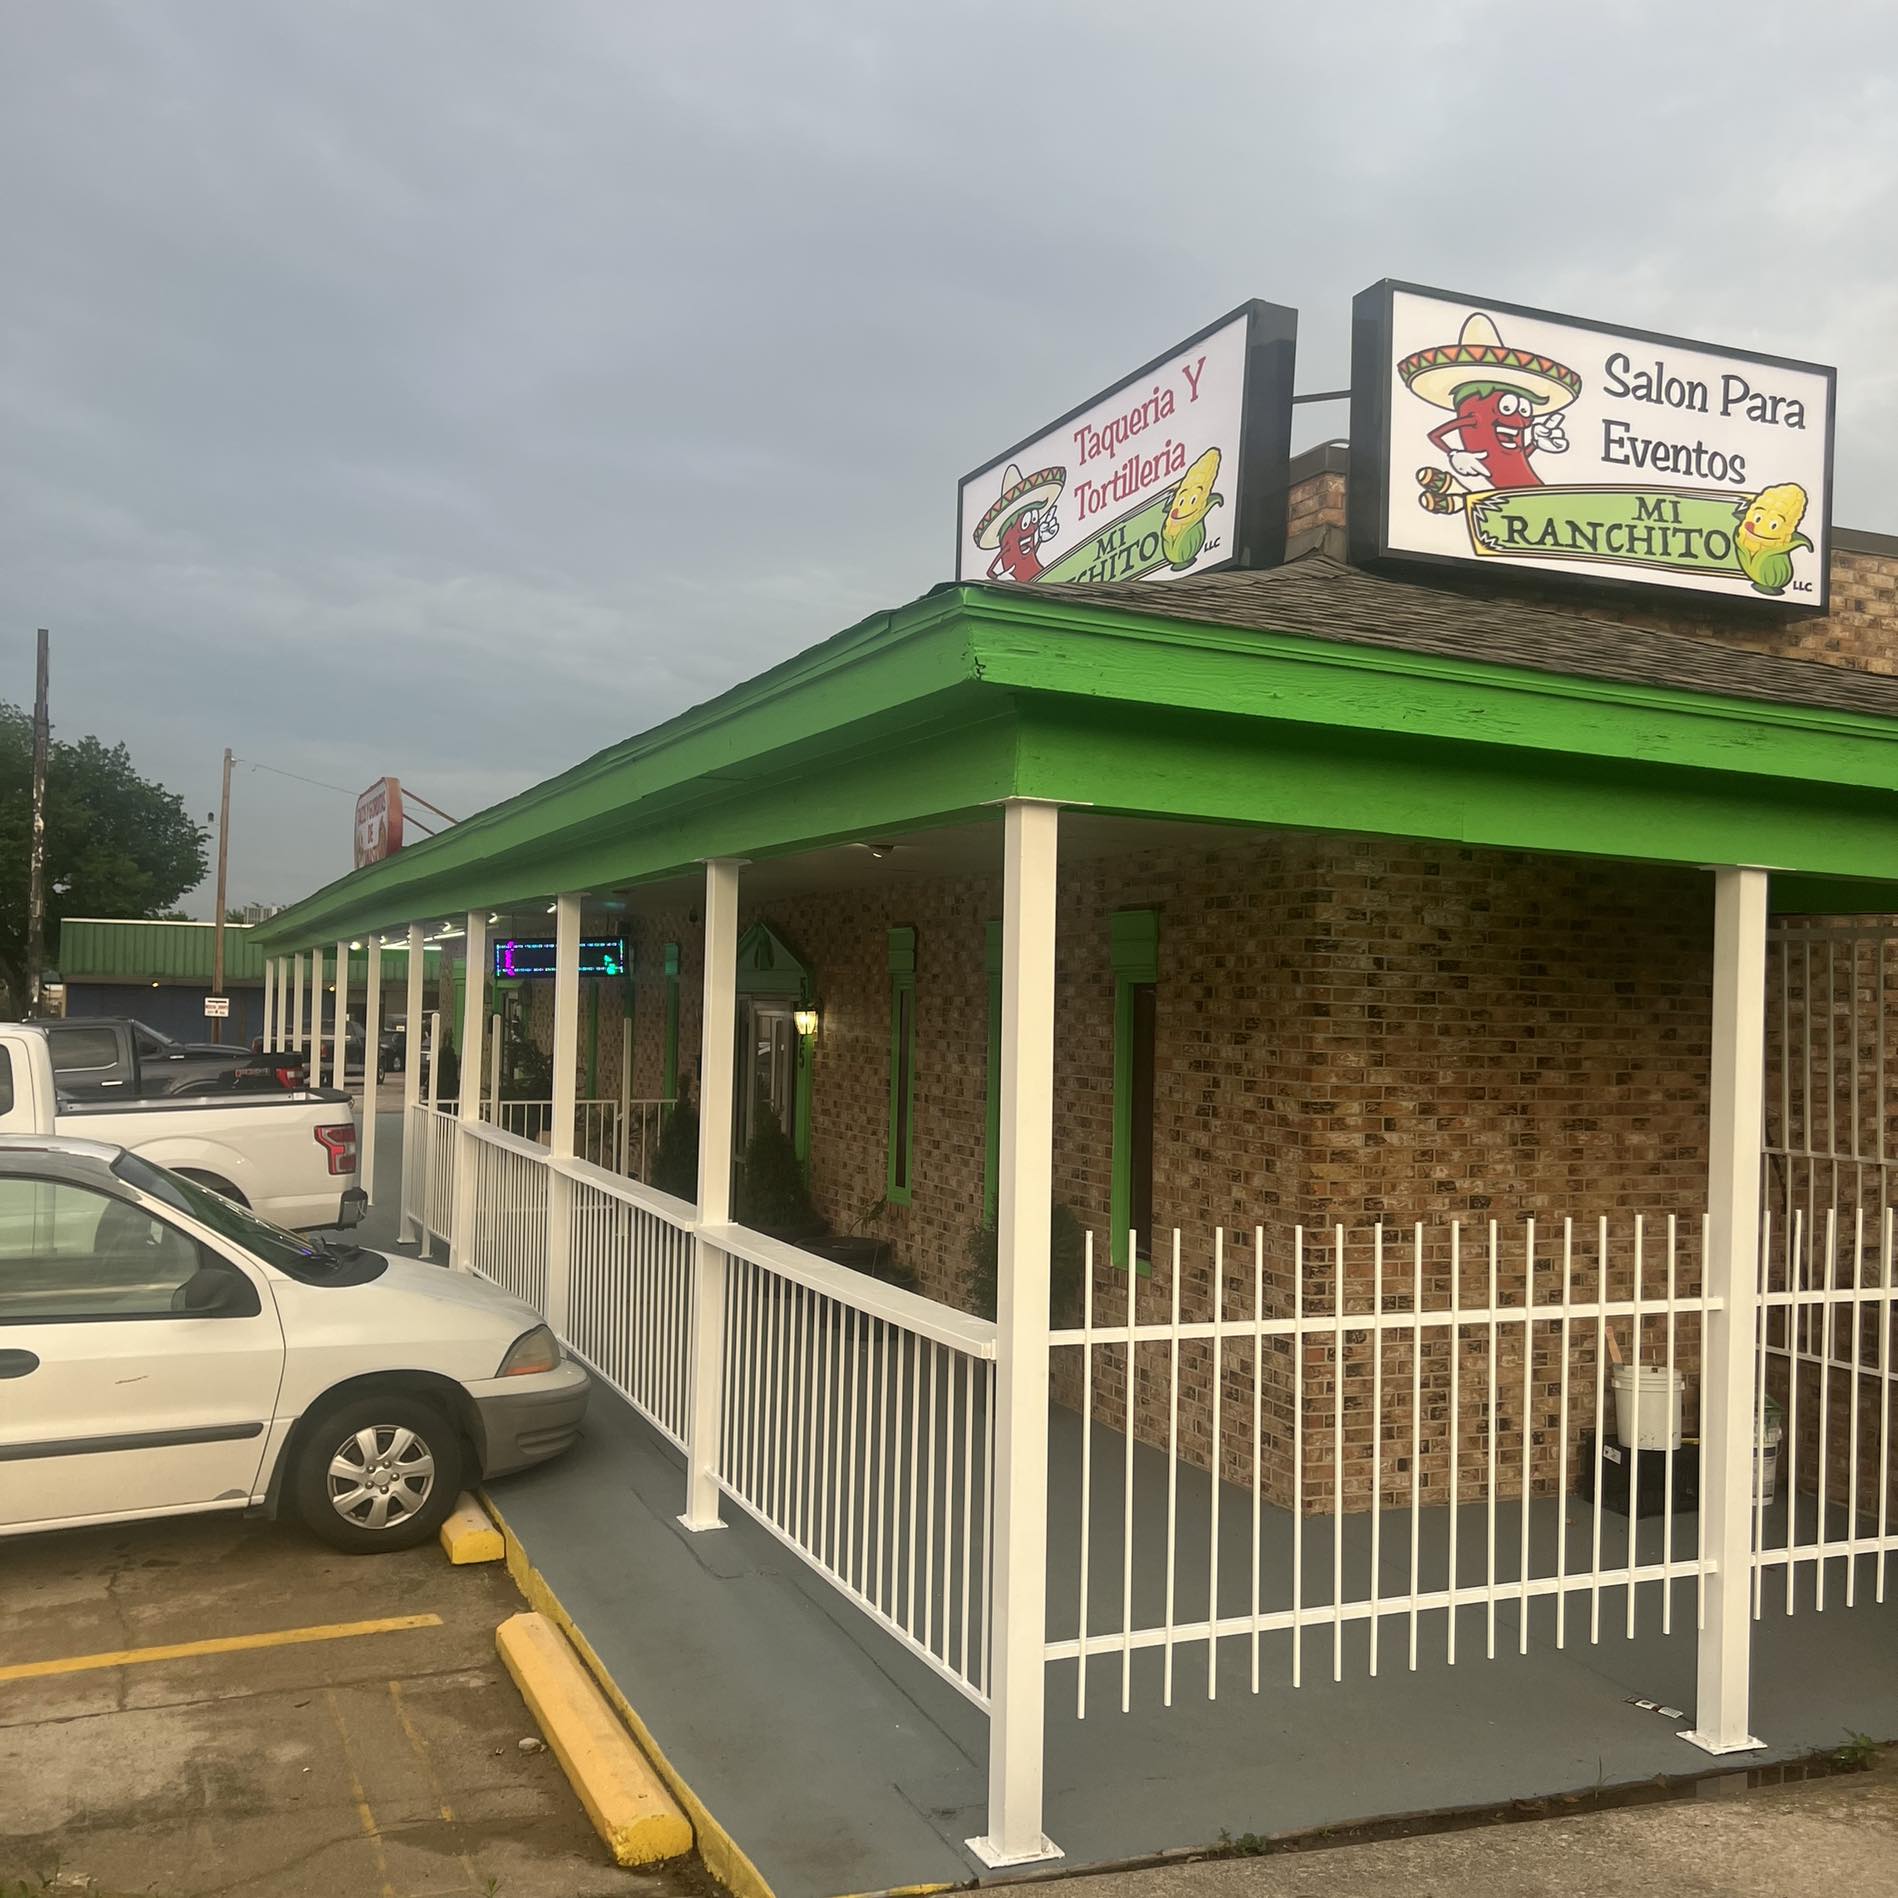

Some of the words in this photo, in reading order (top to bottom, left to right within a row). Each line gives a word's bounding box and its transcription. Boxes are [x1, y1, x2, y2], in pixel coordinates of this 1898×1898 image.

[1073, 385, 1175, 465] Taqueria
[1181, 356, 1206, 403] Y
[1603, 352, 1708, 413] Salon
[1719, 374, 1806, 430] Para
[1600, 418, 1746, 484] Eventos
[1074, 439, 1186, 521] Tortilleria
[1632, 496, 1682, 524] MI
[1093, 525, 1127, 562] MI
[1204, 536, 1221, 553] LLC
[1500, 514, 1731, 561] RANCHITO
[1793, 580, 1814, 592] LLC
